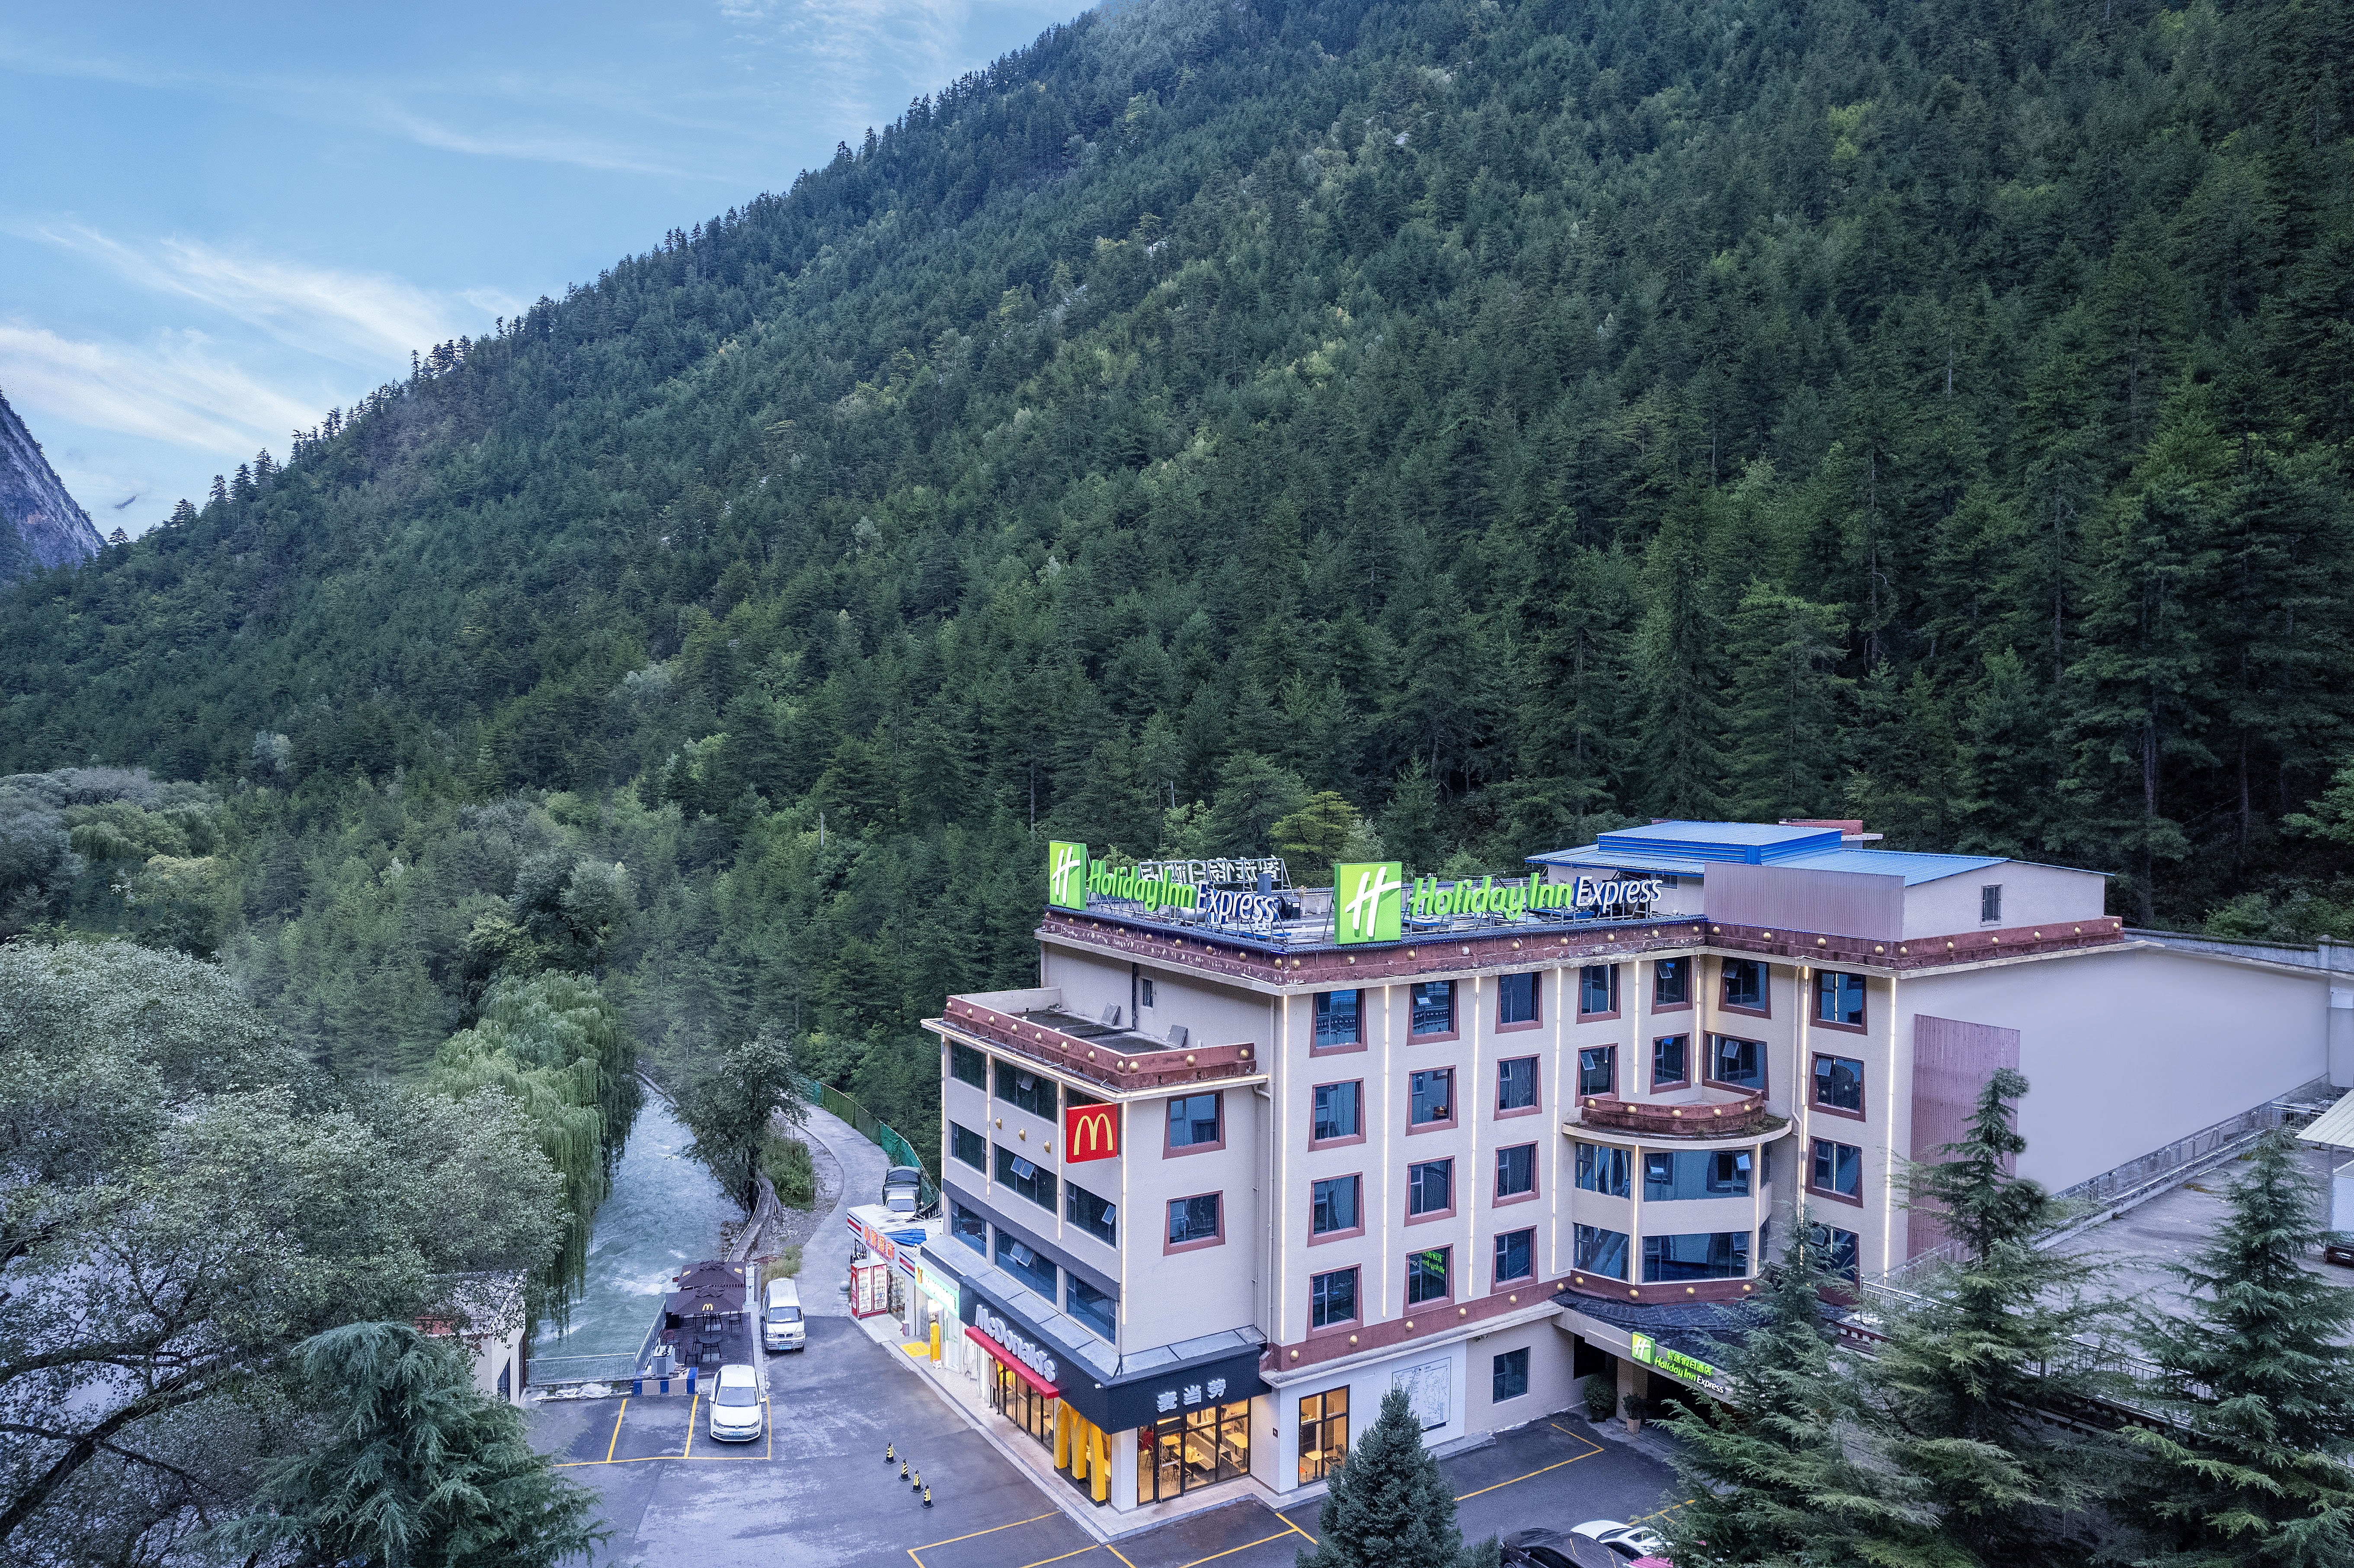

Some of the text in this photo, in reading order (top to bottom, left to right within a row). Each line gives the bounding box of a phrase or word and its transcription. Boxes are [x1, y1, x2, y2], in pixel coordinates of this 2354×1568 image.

[1088, 859, 1277, 923] Holiday Inn Express
[1407, 872, 1663, 920] Holiday Inn Express
[975, 1304, 1056, 1382] McDonald's
[1667, 1350, 1712, 1376] 智选假日酒店
[1157, 1378, 1226, 1413] 麦当劳
[1654, 1356, 1724, 1393] Holiday Inn Express
